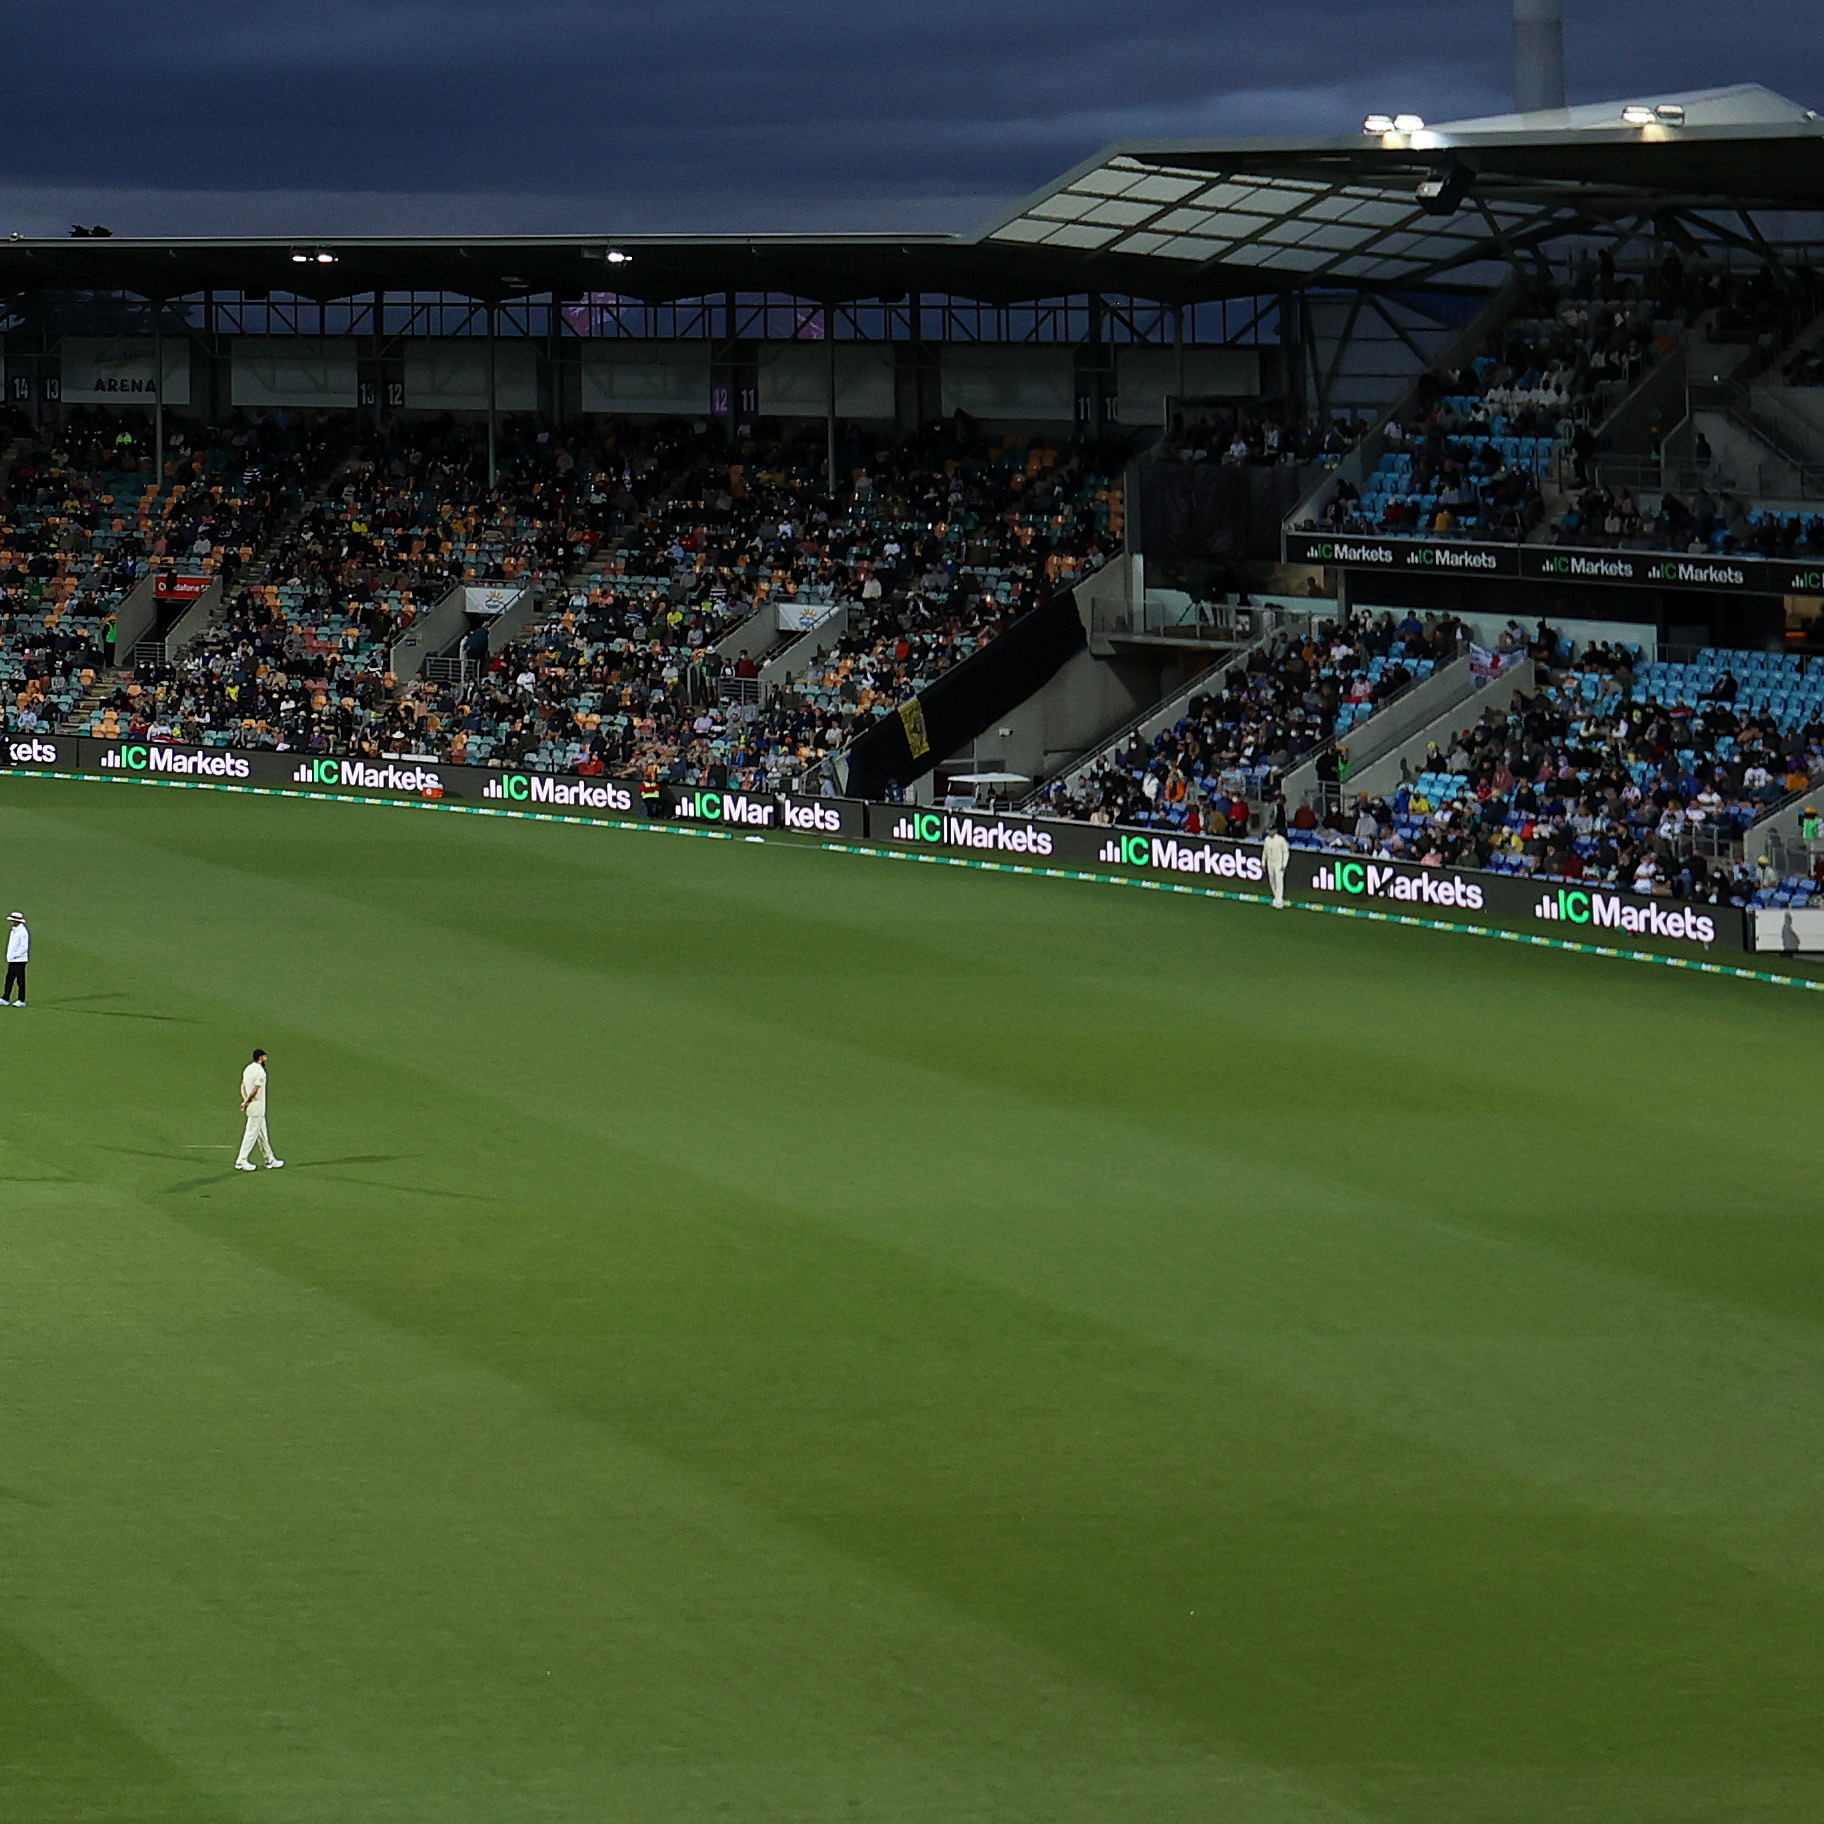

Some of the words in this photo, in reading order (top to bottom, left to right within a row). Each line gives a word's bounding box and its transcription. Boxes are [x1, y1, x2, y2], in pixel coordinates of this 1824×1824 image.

[13, 378, 29, 398] 14
[94, 378, 156, 393] ARENA
[388, 383, 402, 405] 12
[714, 389, 728, 412] 12
[741, 389, 755, 412] 11
[1334, 544, 1393, 563] Markets
[1436, 550, 1497, 569] Markets
[1571, 557, 1633, 577] Markets
[1678, 564, 1744, 584] Markets
[150, 746, 249, 778] Markets
[341, 760, 439, 791] Markets
[530, 777, 631, 810] Markets
[951, 817, 1053, 855] Markets
[1152, 839, 1263, 881] Markets
[1367, 864, 1484, 910] Markets
[1592, 893, 1716, 943] Markets
